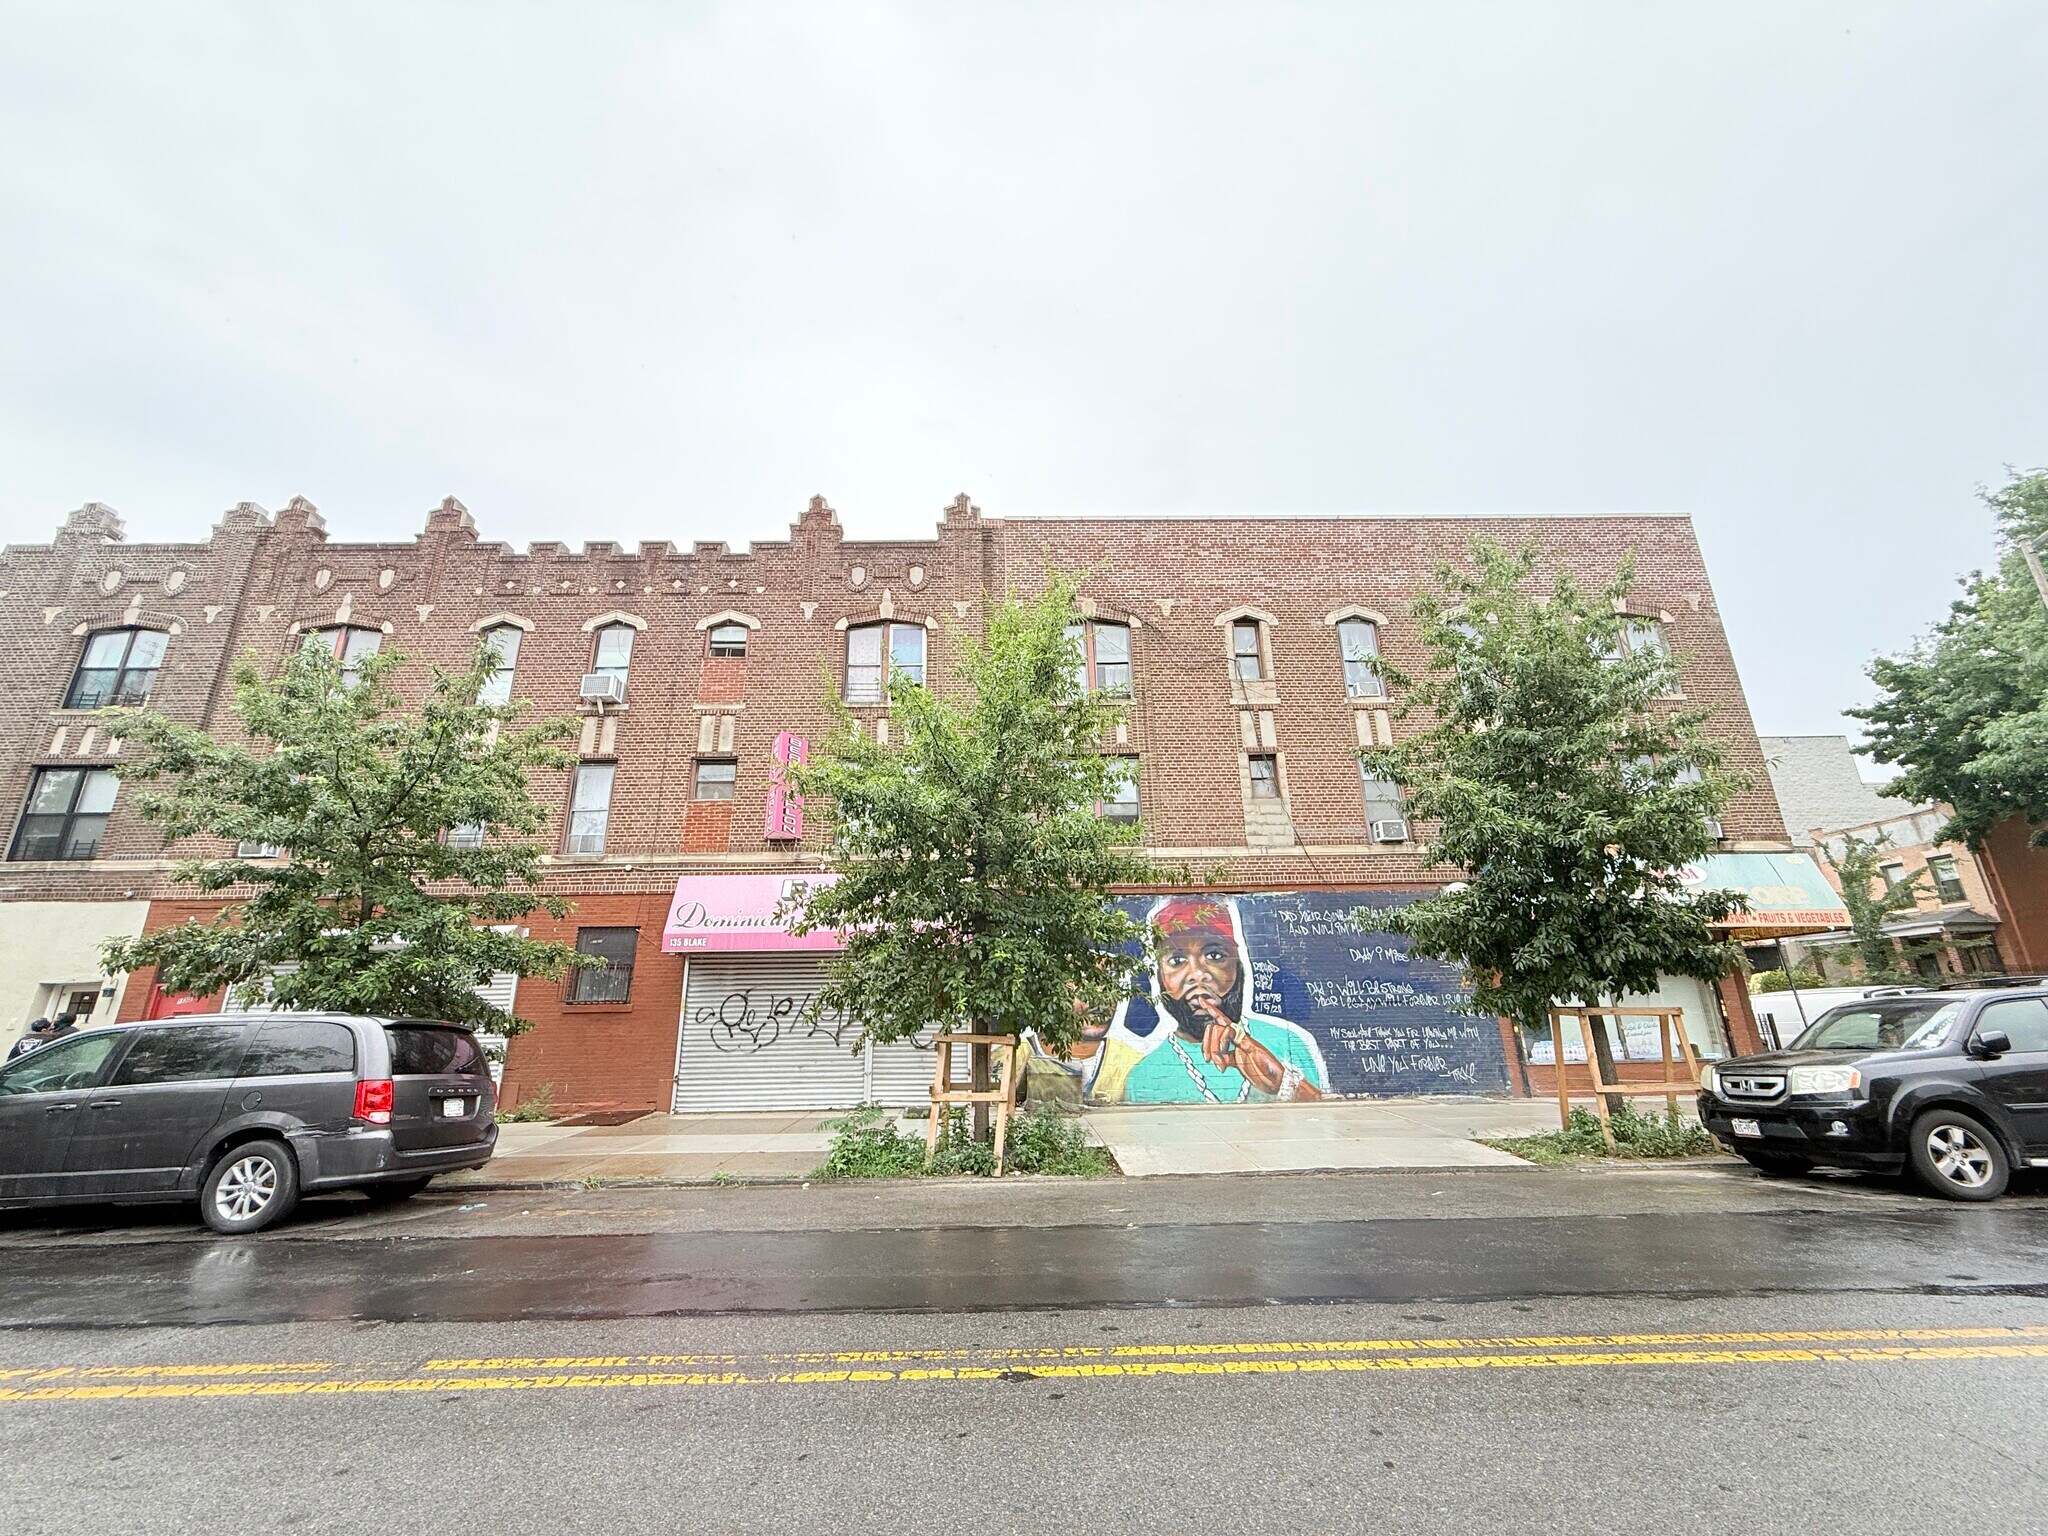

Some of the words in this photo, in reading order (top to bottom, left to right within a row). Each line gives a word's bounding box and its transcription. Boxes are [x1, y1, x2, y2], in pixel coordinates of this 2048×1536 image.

[672, 901, 796, 929] Dominican
[1759, 912, 1786, 924] FRUITS
[1788, 912, 1794, 923] &
[1795, 912, 1846, 924] VEGETABLES
[1289, 923, 1309, 937] AND
[1311, 922, 1334, 936] NOW
[669, 938, 682, 947] 135
[683, 938, 708, 947] BLAKE
[1384, 1037, 1408, 1052] PART
[1410, 1039, 1421, 1049] OF
[1387, 1054, 1409, 1075] YOU
